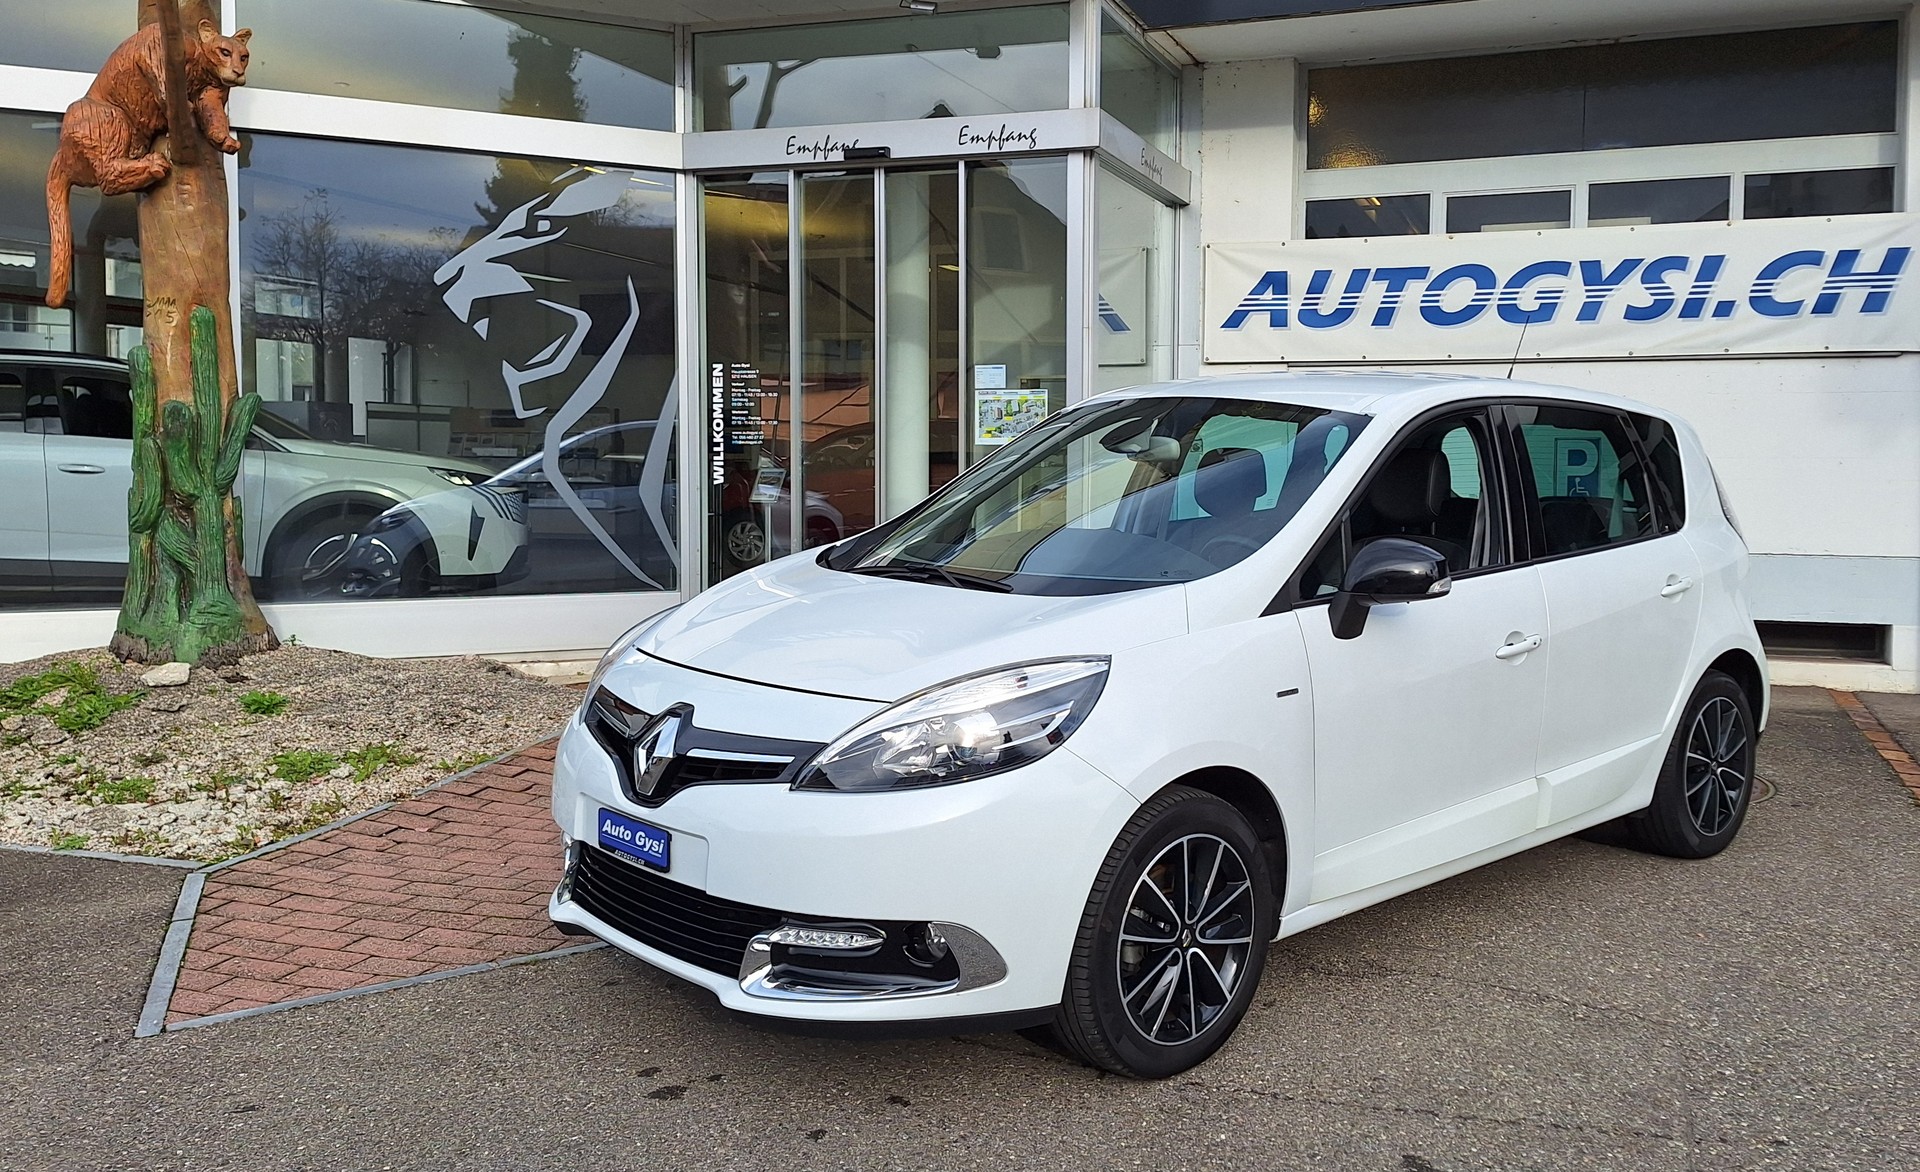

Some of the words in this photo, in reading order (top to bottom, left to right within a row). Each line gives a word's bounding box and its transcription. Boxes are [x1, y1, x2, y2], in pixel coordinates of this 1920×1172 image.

[958, 124, 1038, 151] Empfang
[1219, 246, 1914, 328] AUTOGYSI.CH
[712, 363, 725, 485] WILLKOMMEN
[602, 819, 632, 841] Auto
[635, 831, 665, 853] Gysi
